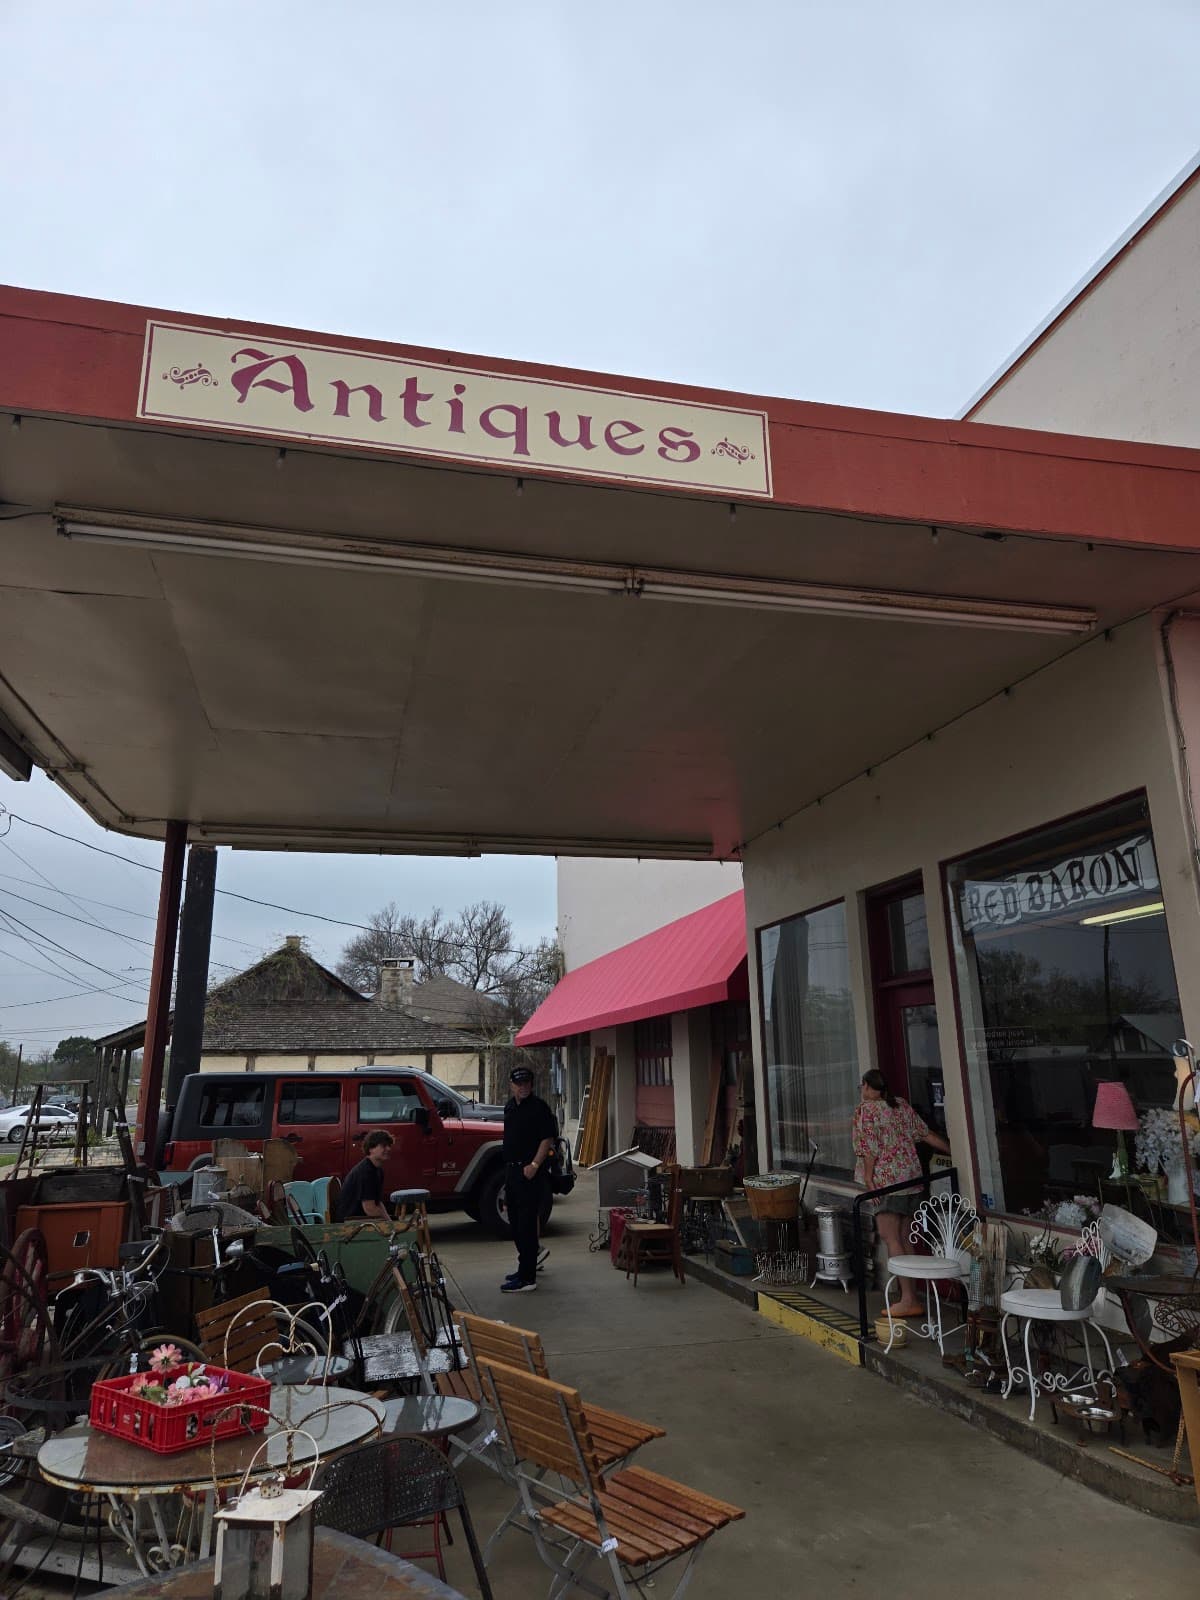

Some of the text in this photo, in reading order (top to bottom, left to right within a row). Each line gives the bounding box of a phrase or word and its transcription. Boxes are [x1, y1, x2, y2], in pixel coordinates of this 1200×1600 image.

[229, 346, 701, 464] Antiques
[965, 847, 1142, 922] RED BARON
